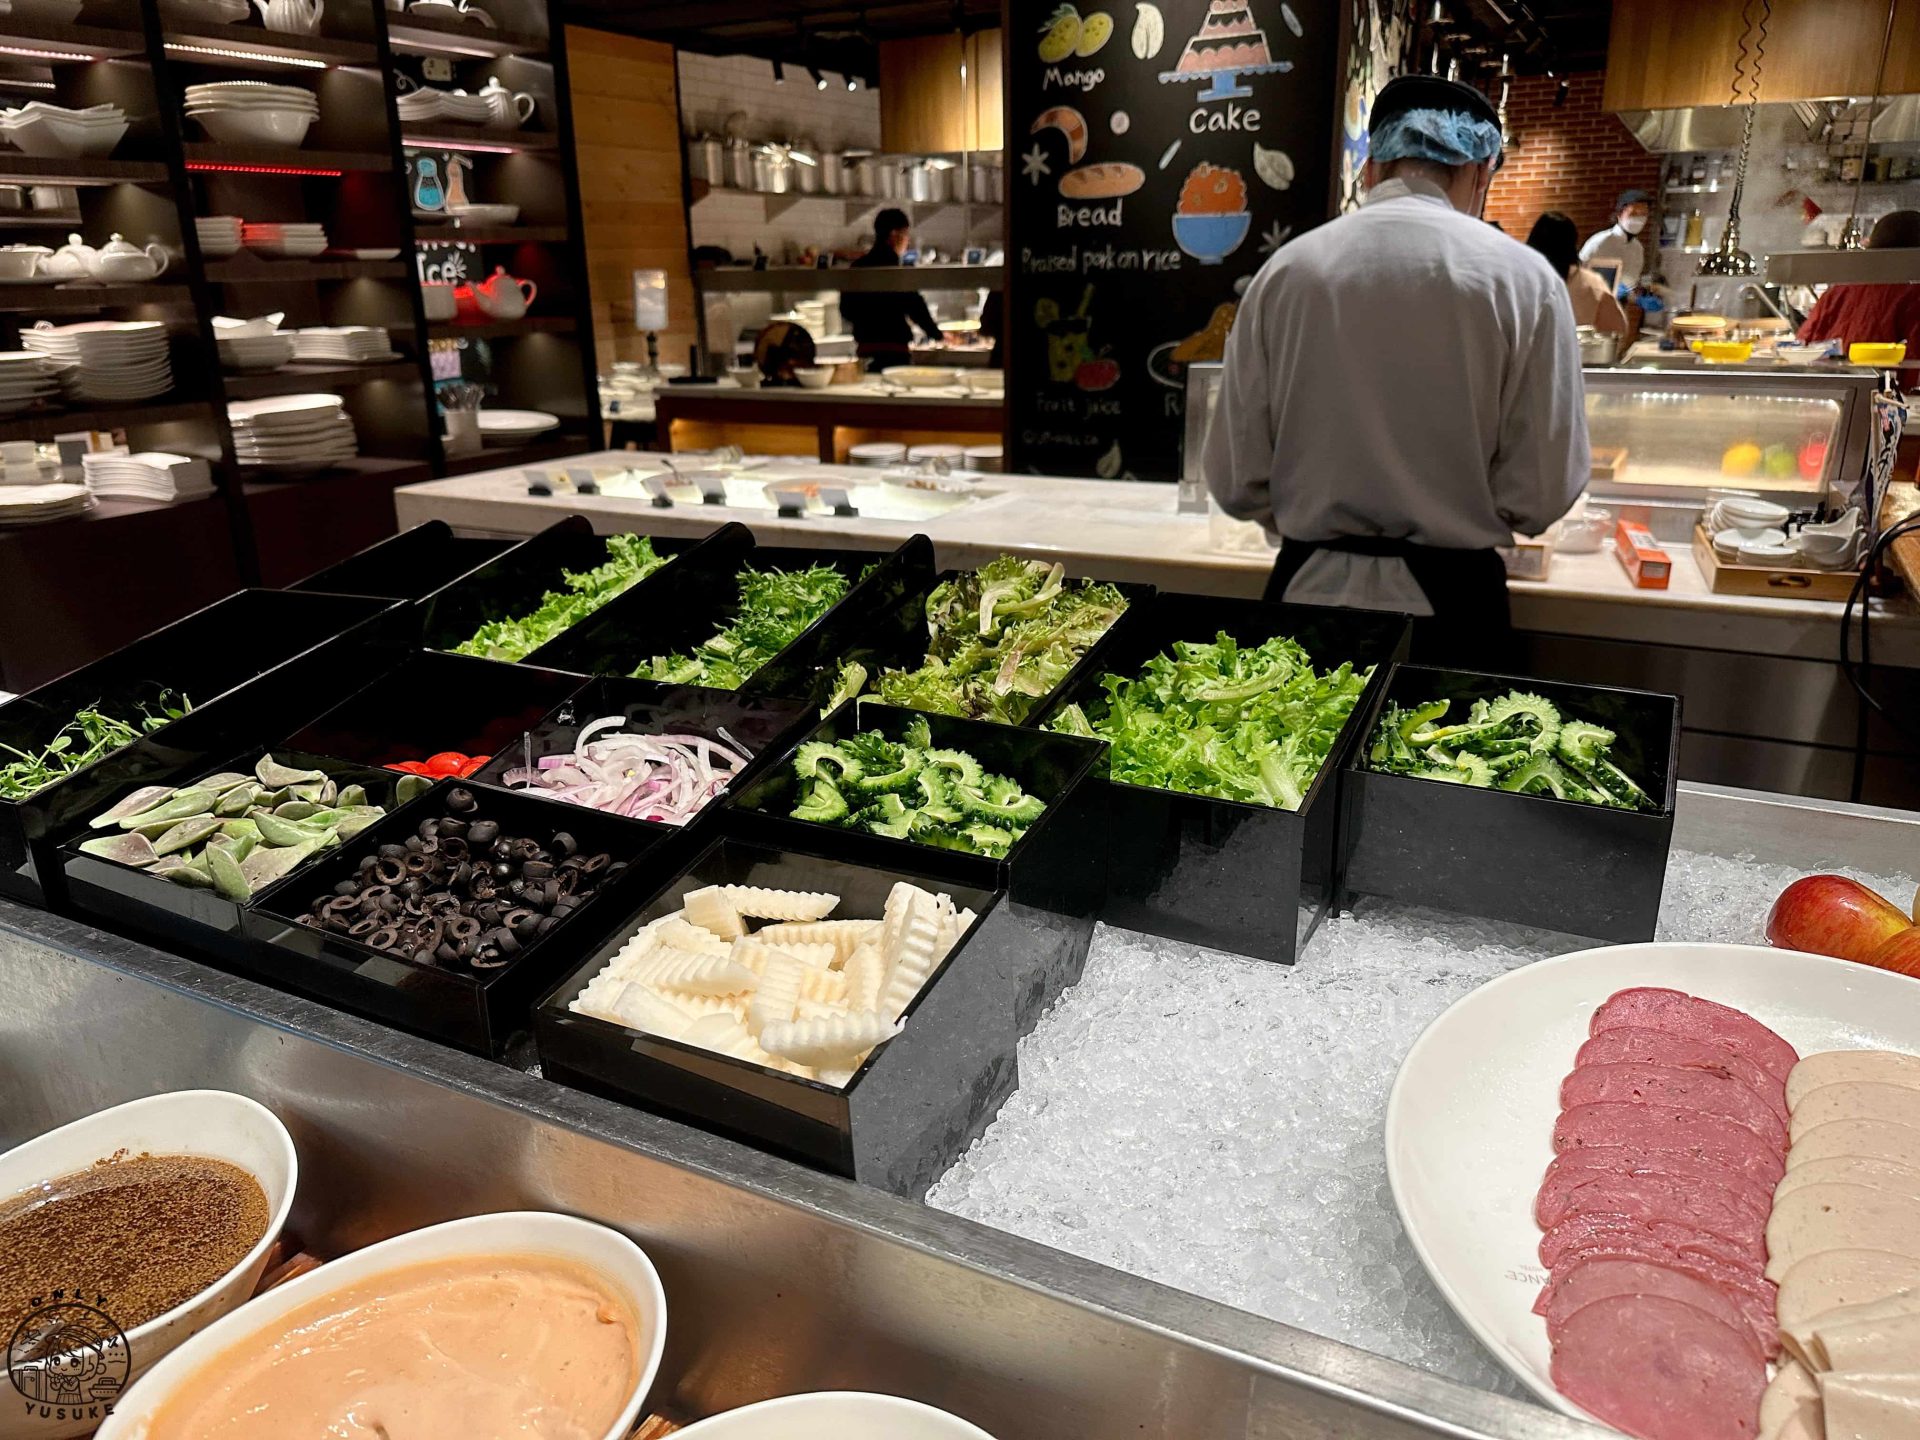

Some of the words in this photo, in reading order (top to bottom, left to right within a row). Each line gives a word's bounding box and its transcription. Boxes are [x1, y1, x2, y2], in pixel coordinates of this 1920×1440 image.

[1043, 67, 1105, 92] Mango
[1189, 102, 1261, 133] Cake
[1056, 198, 1122, 228] Bread
[416, 253, 457, 284] Ice
[1142, 248, 1182, 271] rice
